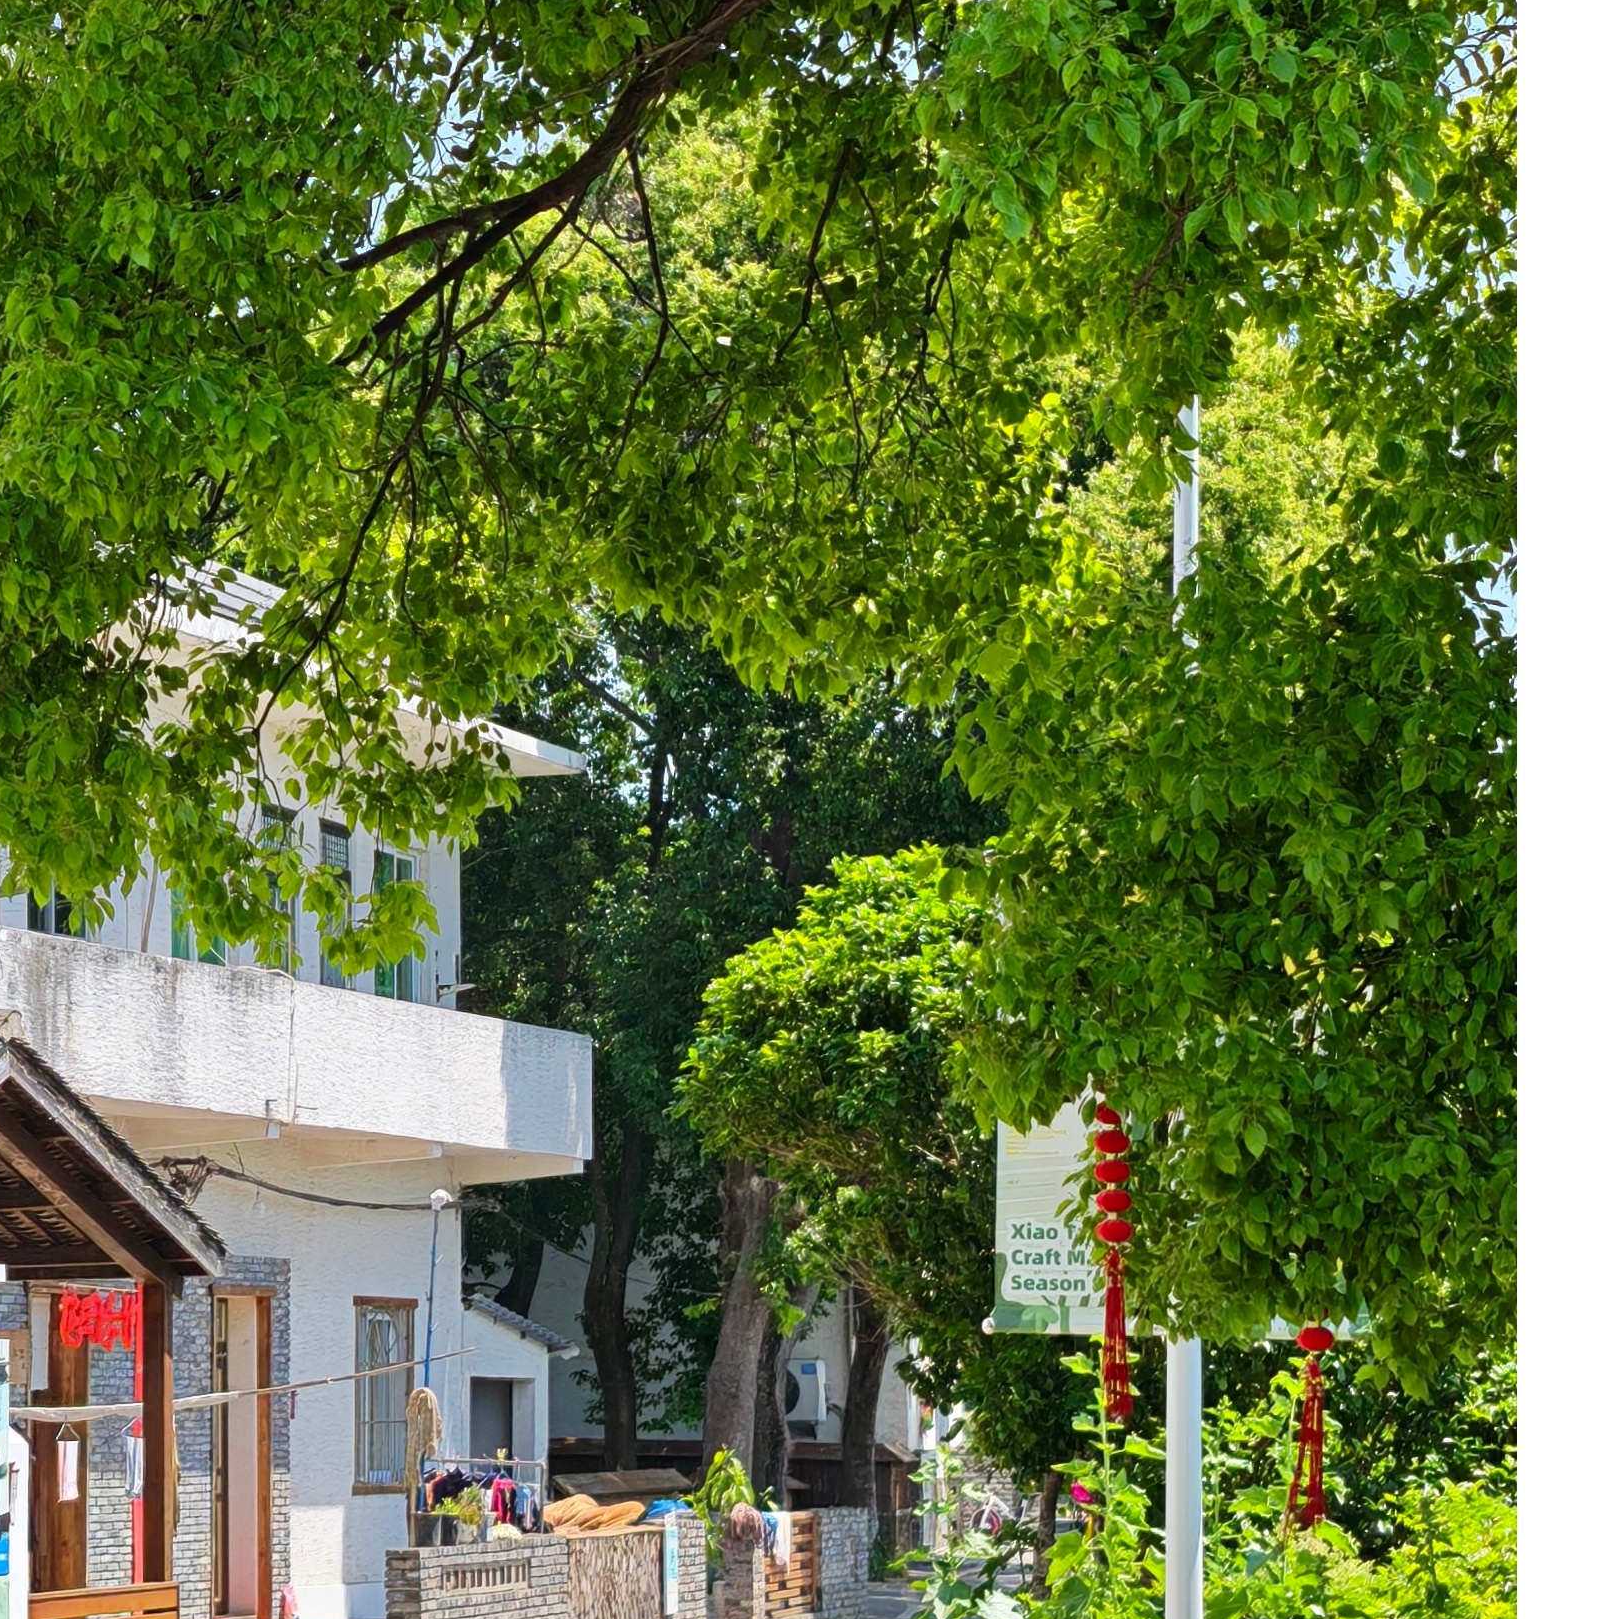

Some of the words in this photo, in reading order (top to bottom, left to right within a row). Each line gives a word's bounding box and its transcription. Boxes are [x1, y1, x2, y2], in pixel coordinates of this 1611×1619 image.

[1011, 1222, 1058, 1240] Xiao
[1011, 1248, 1061, 1265] Craft
[1011, 1275, 1086, 1292] Season
